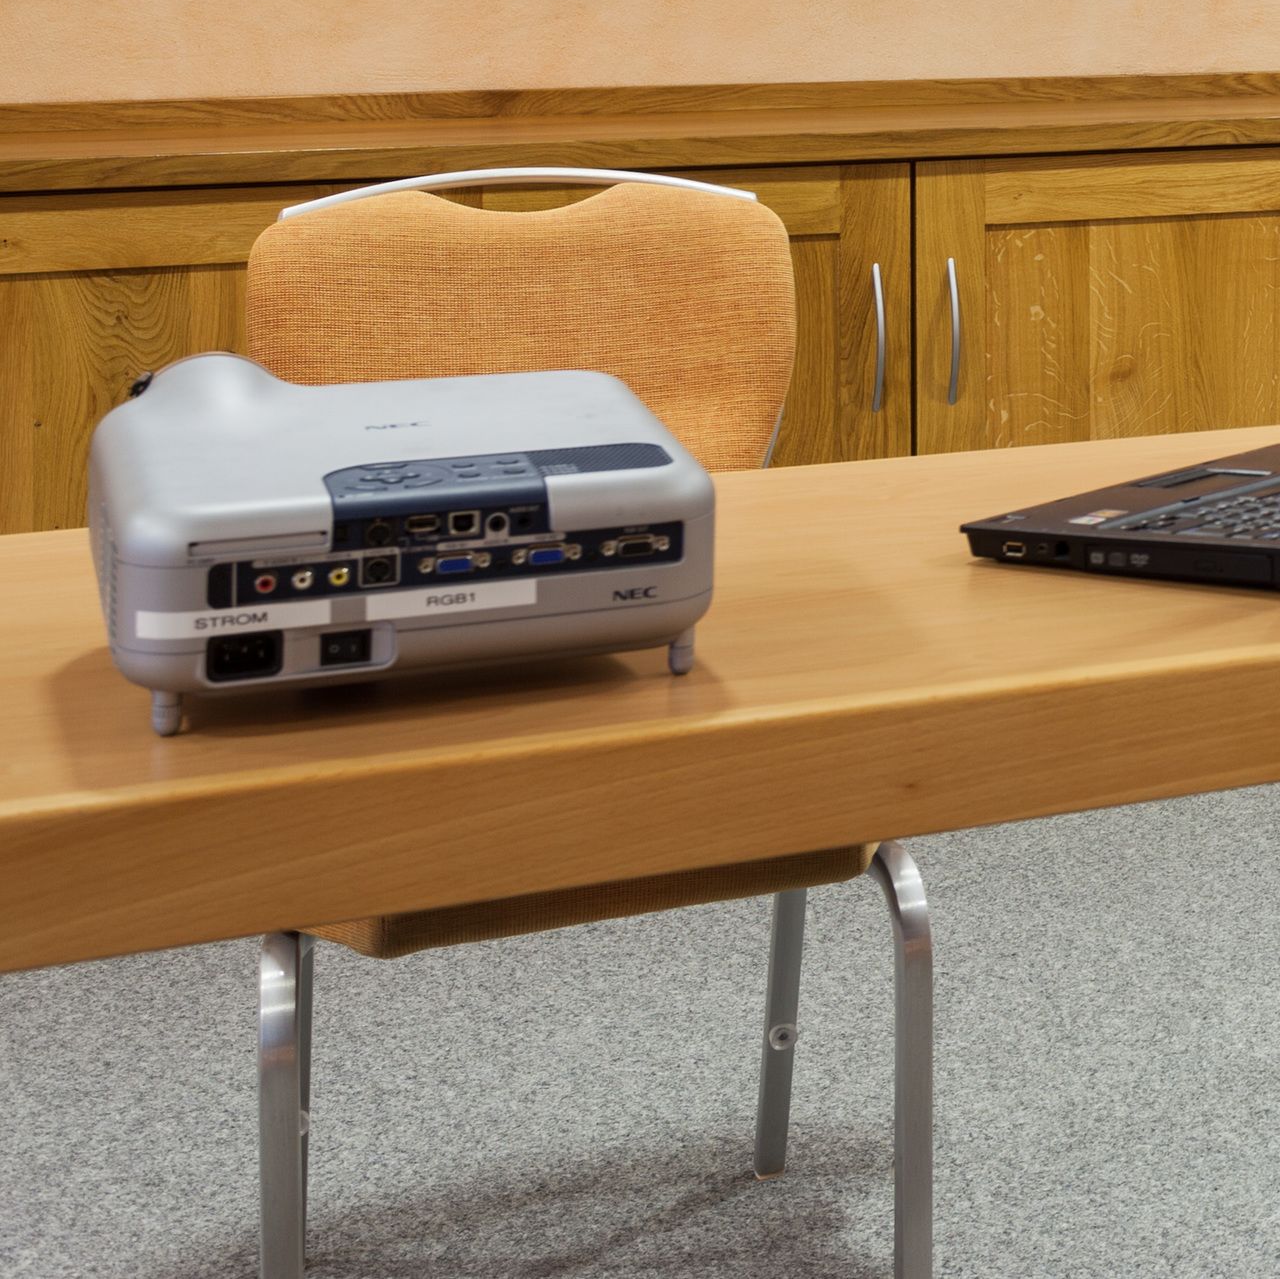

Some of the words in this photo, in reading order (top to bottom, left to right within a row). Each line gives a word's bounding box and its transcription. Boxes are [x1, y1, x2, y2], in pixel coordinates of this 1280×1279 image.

[425, 592, 477, 607] RGB1
[612, 586, 660, 602] NEC
[193, 611, 269, 631] STROM
